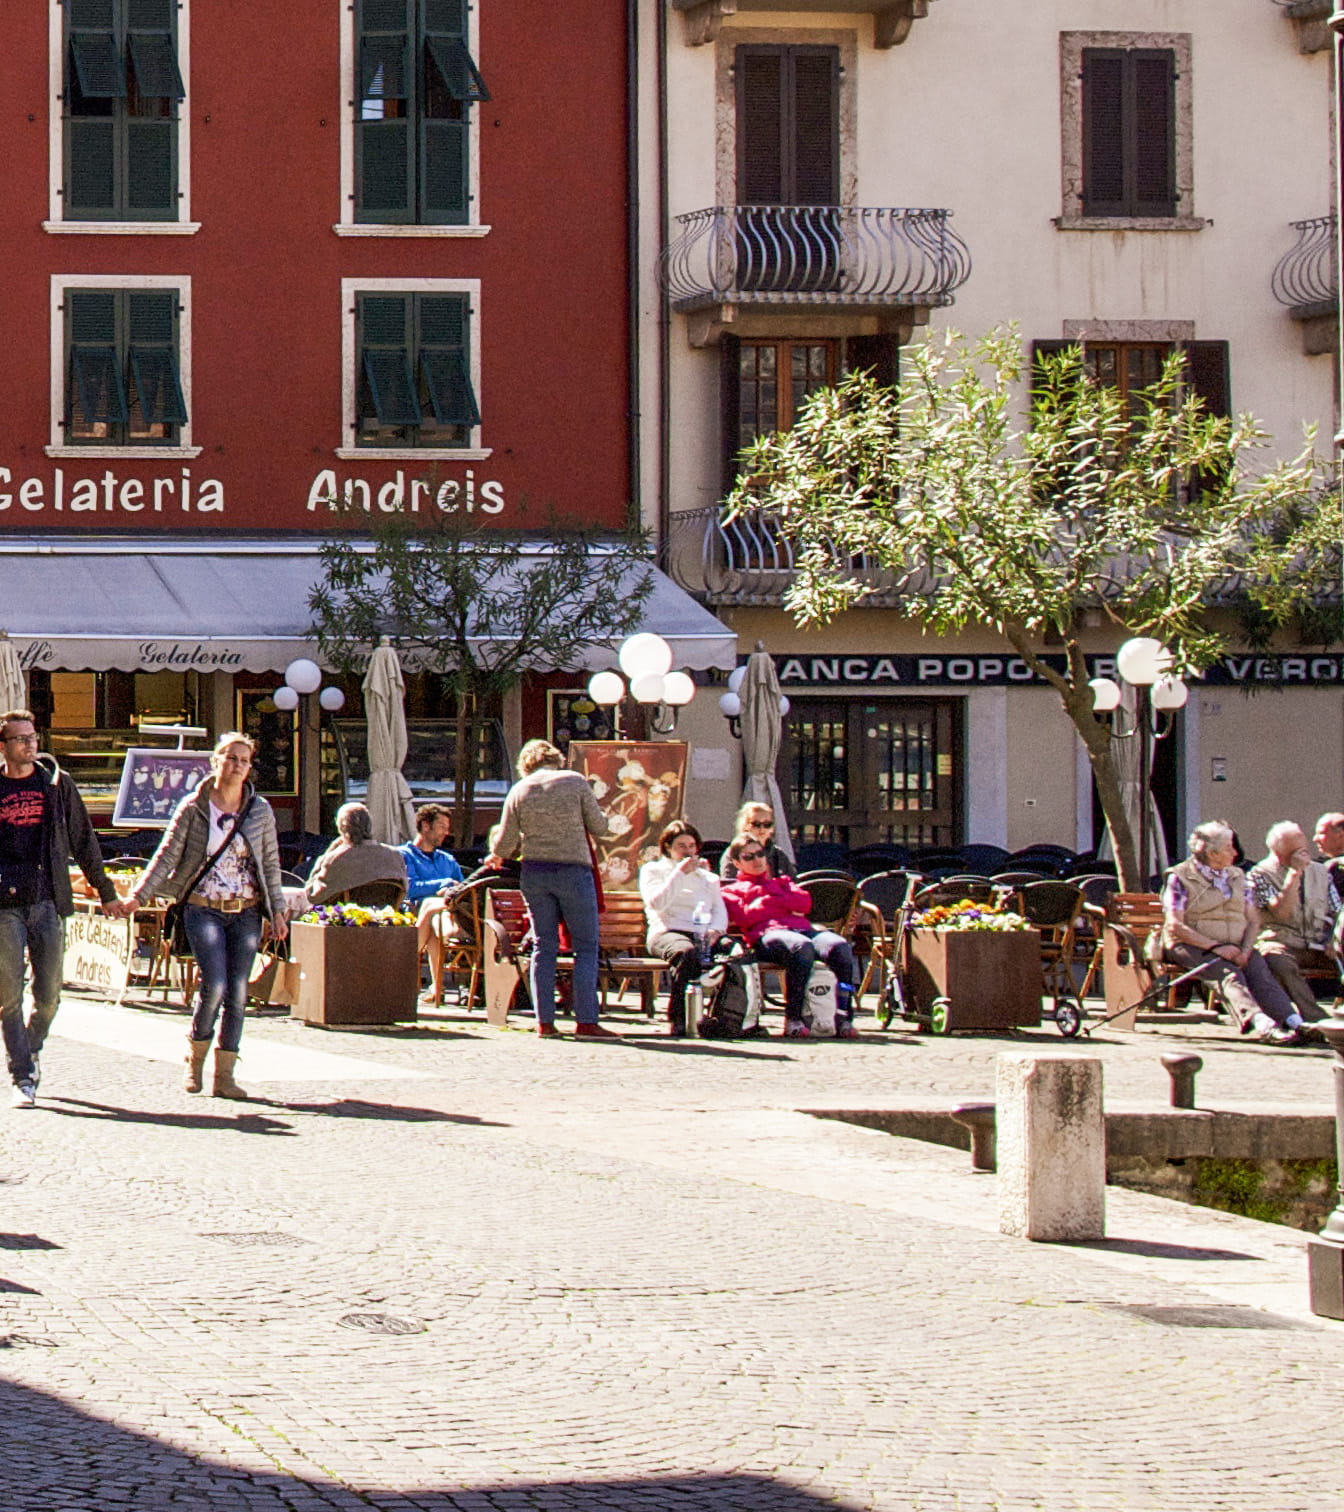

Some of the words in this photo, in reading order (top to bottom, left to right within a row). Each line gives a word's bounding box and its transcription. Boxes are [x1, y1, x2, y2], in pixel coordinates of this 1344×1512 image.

[306, 468, 505, 514] Andreis
[139, 641, 243, 666] Gelateria
[779, 658, 900, 681] ANCA
[1224, 658, 1344, 681] VERO
